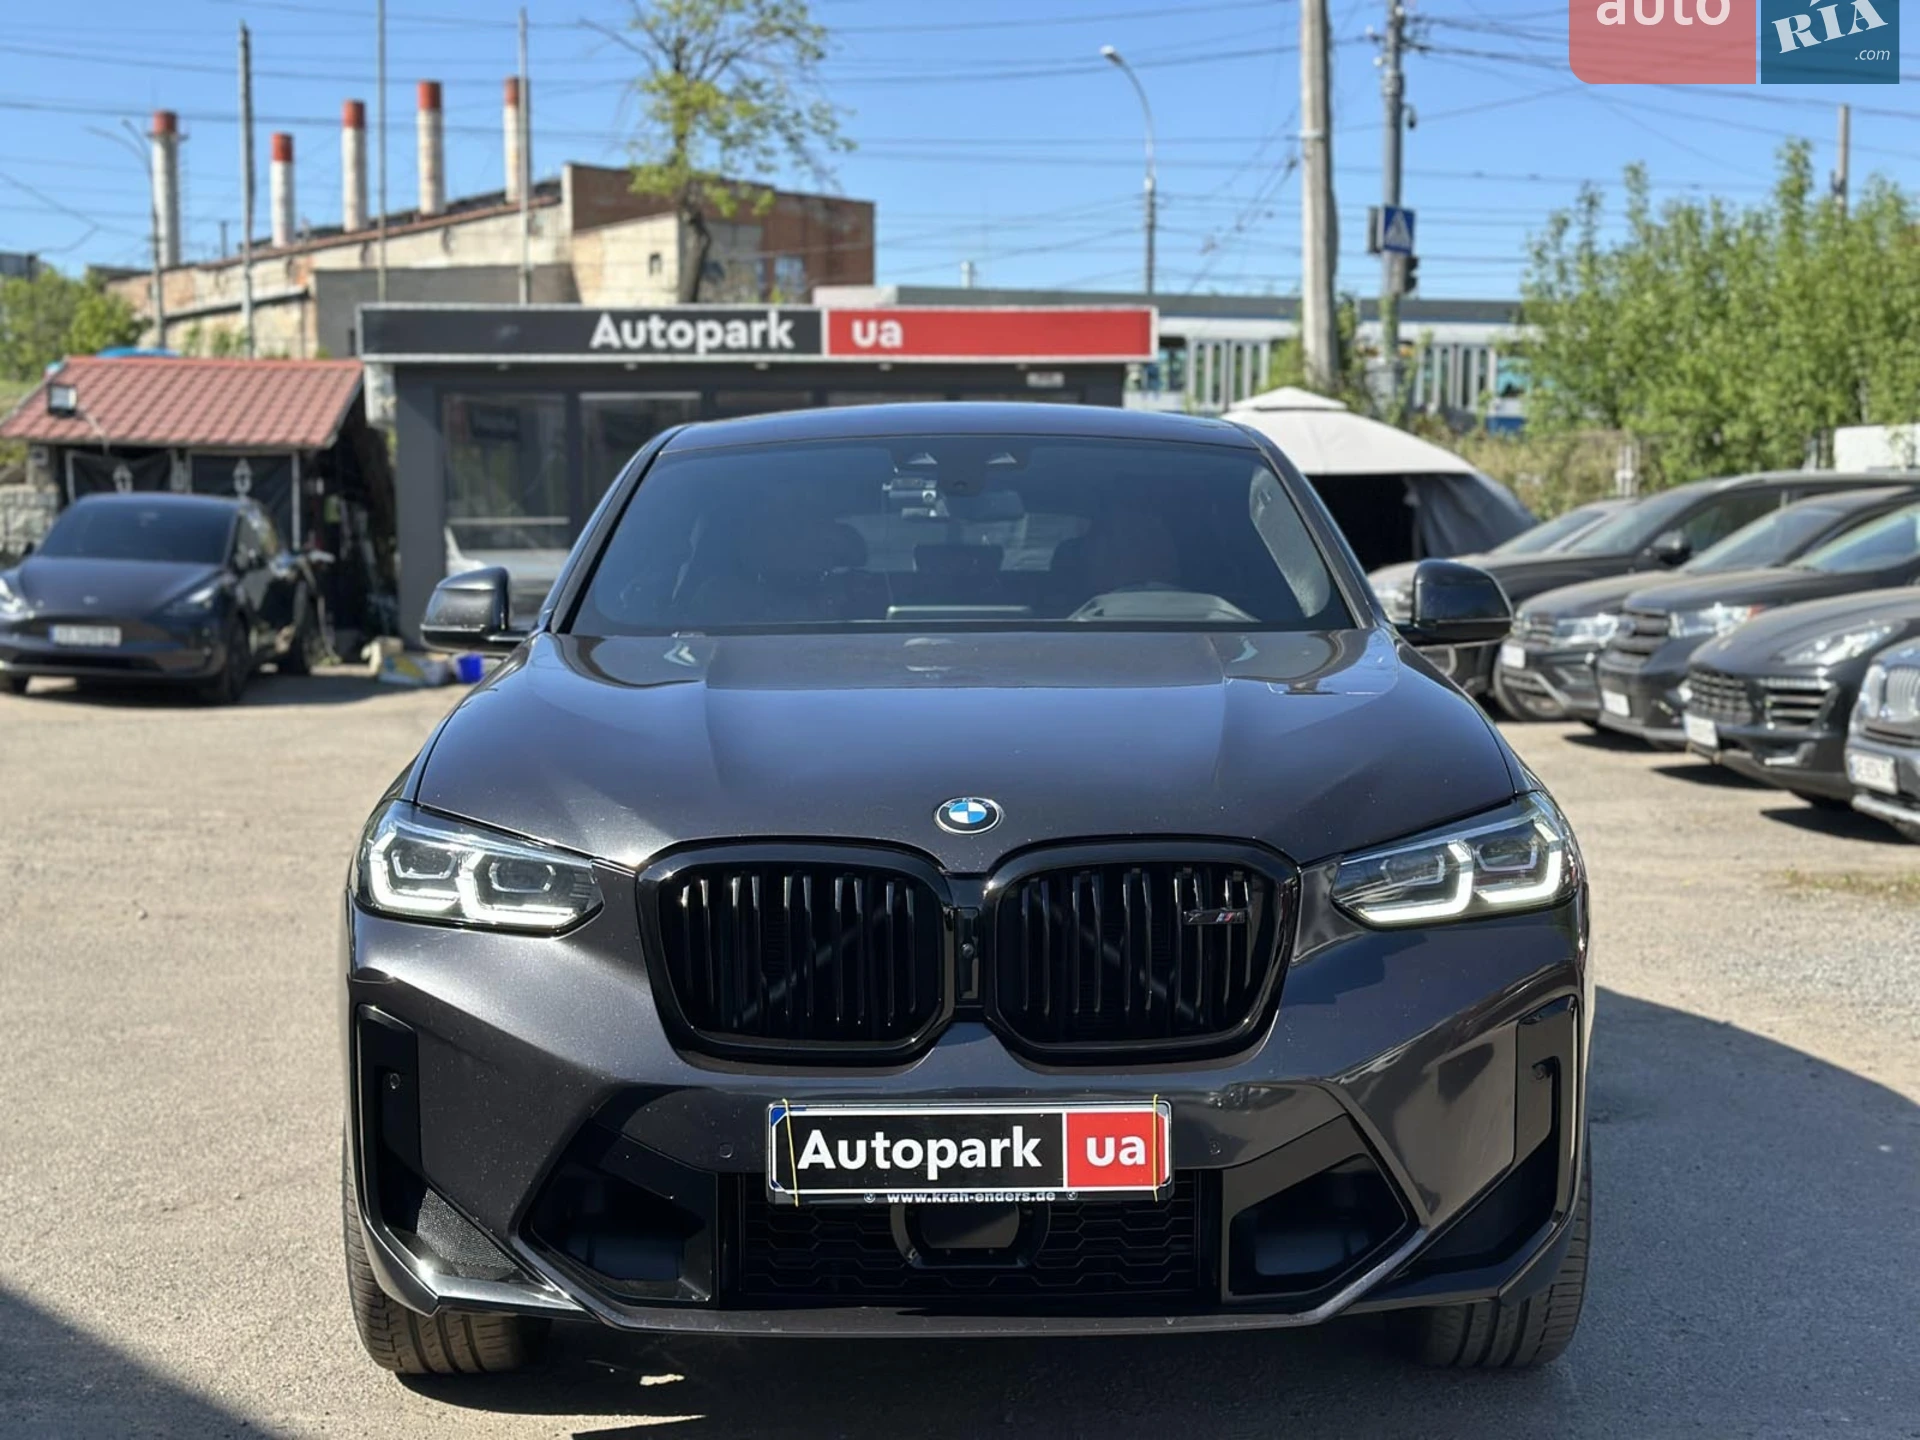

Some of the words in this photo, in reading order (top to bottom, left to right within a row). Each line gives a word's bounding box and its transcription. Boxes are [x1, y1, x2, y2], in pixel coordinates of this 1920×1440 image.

[590, 311, 796, 355] Autopark
[850, 319, 904, 348] ua
[797, 1125, 1042, 1181] Autopark
[1085, 1134, 1147, 1167] ua
